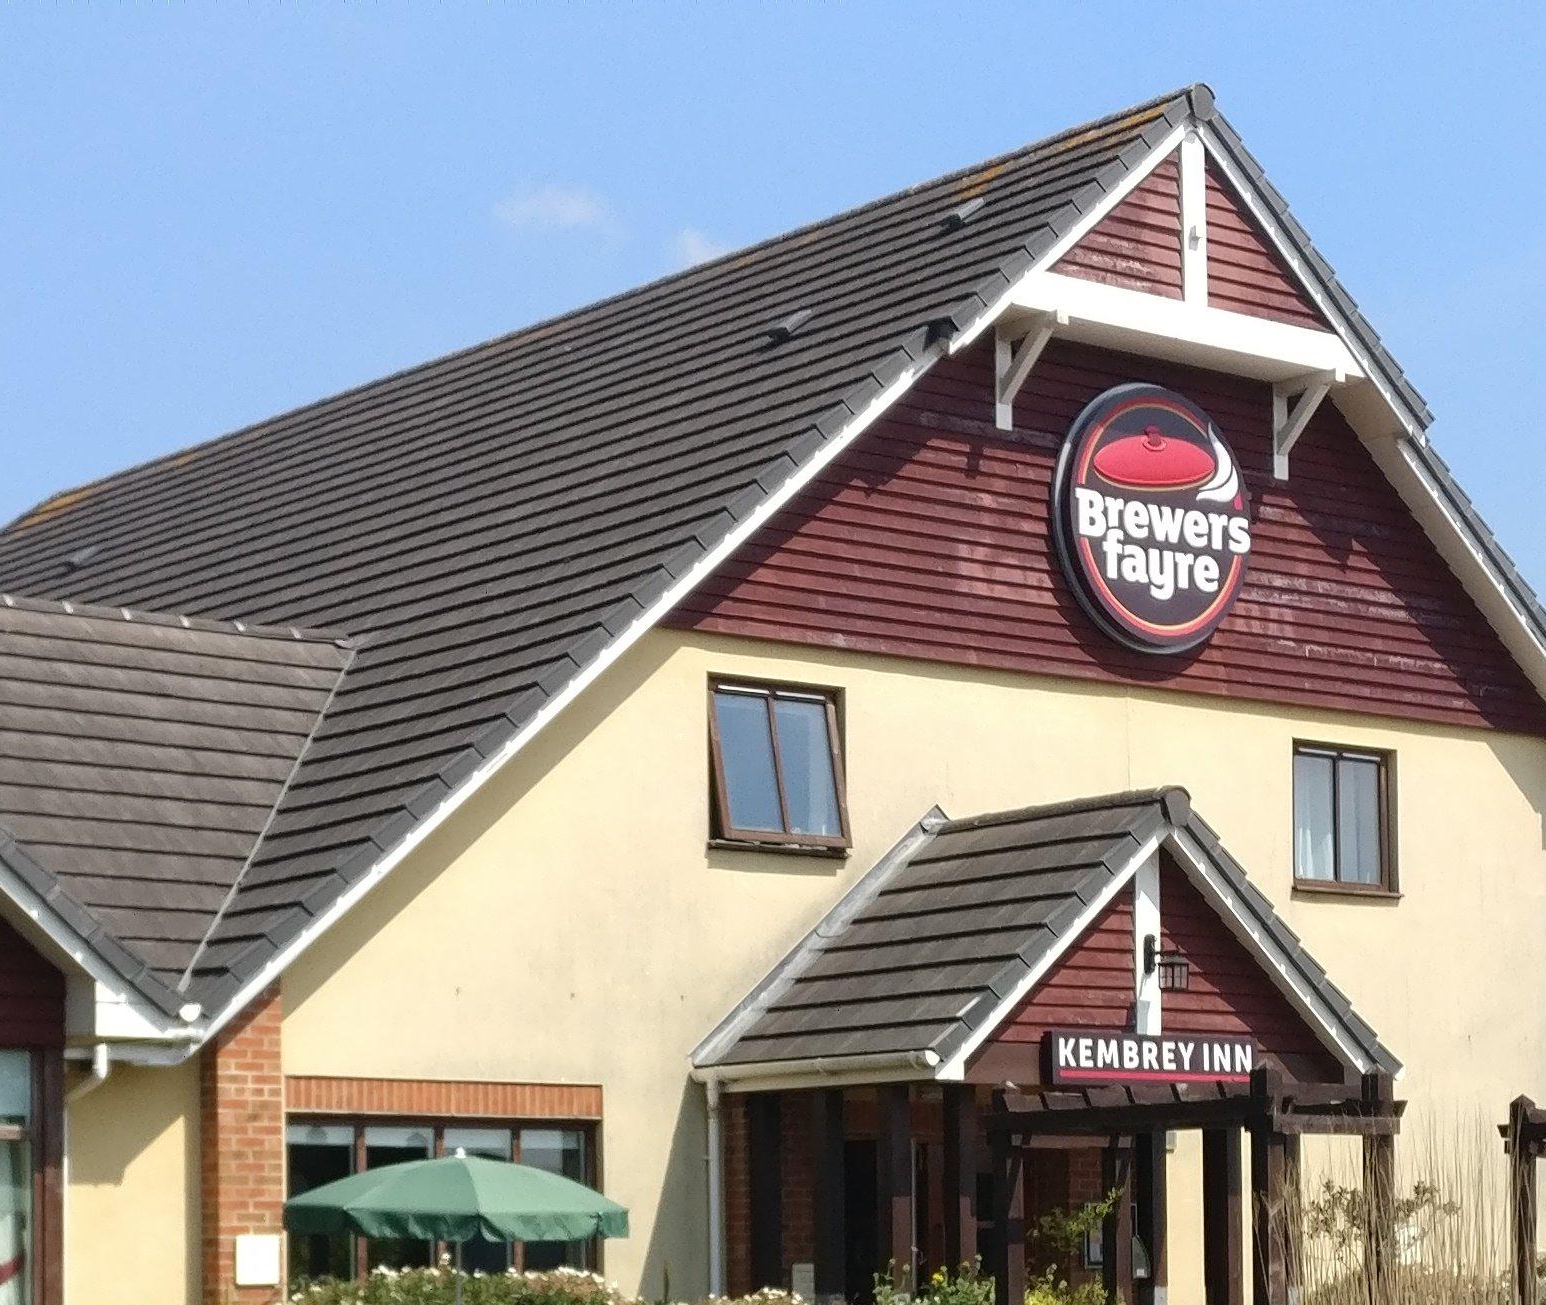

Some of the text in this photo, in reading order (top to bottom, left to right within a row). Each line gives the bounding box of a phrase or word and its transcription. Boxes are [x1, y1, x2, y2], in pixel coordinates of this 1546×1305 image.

[1074, 486, 1251, 554] Brewers
[1102, 528, 1220, 601] fayre
[1058, 1037, 1252, 1073] KEMBREY INN
